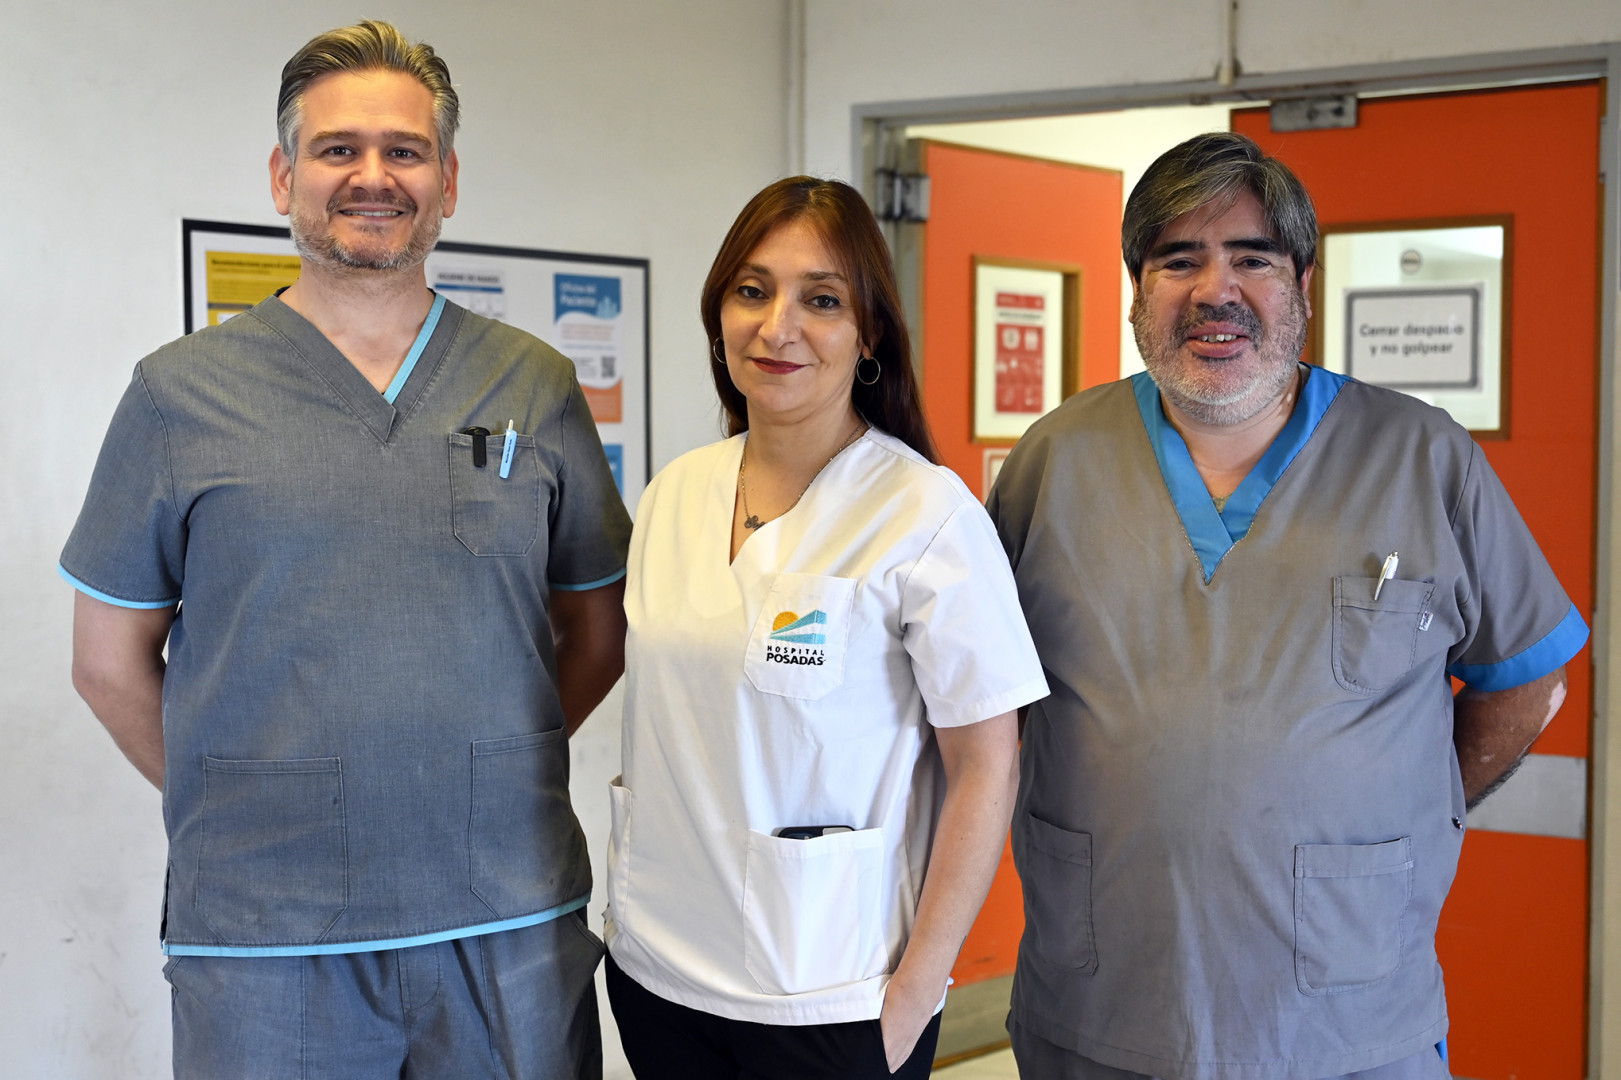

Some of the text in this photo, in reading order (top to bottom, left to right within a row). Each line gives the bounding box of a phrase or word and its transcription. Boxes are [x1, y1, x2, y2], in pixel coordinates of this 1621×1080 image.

[1360, 323, 1464, 338] Cerrar despaco
[1369, 341, 1453, 357] y no golpear
[767, 645, 825, 656] HOSPITAL
[766, 652, 825, 666] POSADAS
